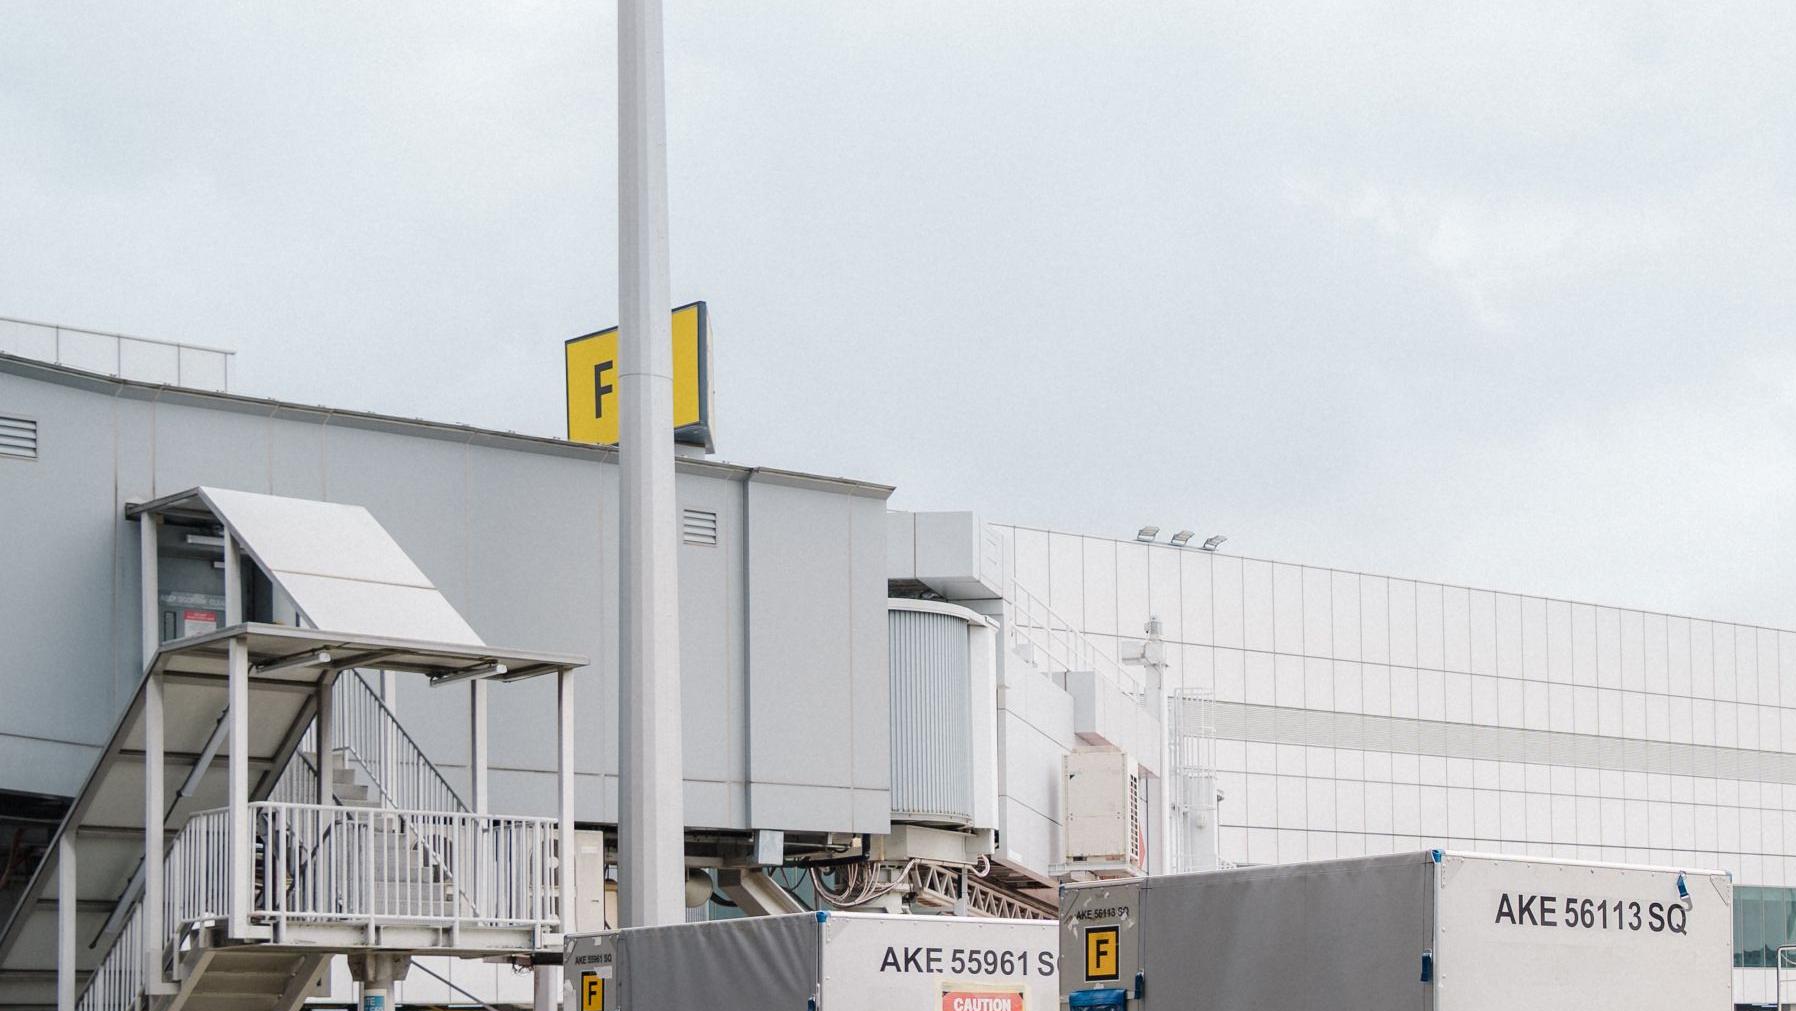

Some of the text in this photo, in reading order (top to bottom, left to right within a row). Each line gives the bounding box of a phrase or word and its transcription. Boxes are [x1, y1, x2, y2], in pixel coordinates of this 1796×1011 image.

[1076, 910, 1093, 920] AKE
[1495, 893, 1687, 936] AKE 56113 SQ
[879, 946, 1060, 976] AKE 55961 S
[1096, 939, 1109, 968] F
[589, 981, 598, 1006] F
